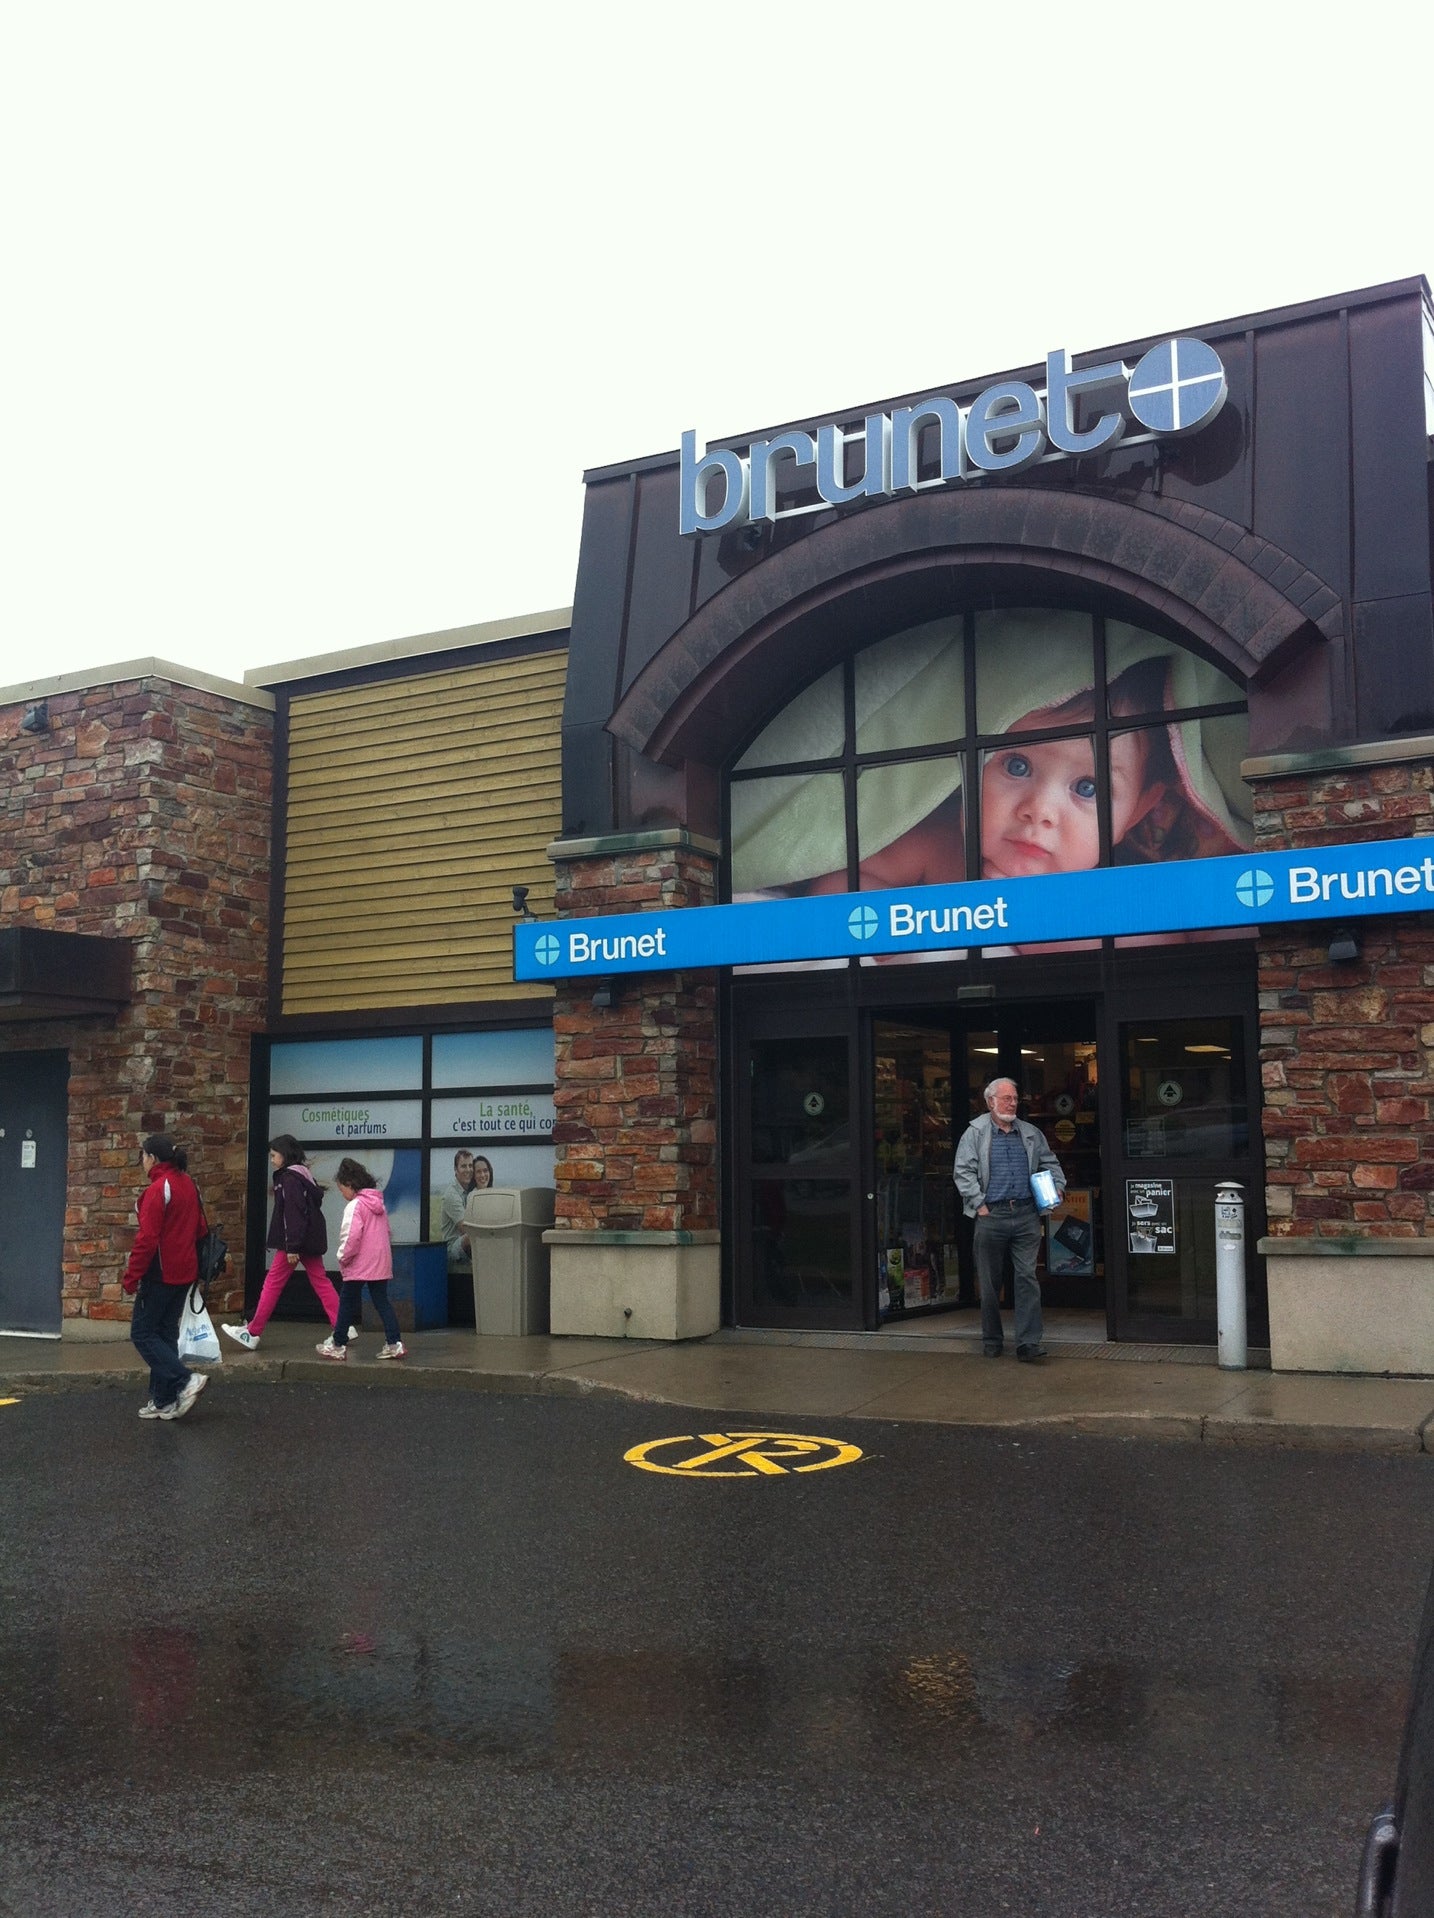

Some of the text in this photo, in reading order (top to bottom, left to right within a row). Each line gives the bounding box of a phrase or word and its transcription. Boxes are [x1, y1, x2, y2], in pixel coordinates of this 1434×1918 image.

[678, 348, 1127, 537] brunet
[1289, 857, 1434, 904] Brunet
[889, 896, 1009, 938] Brunet
[568, 926, 667, 964] Brunet
[301, 1107, 370, 1124] Cosmétiques
[480, 1099, 533, 1118] La santé,
[335, 1121, 387, 1137] et parfums
[452, 1118, 476, 1132] c'est
[480, 1118, 501, 1131] tout
[504, 1120, 516, 1130] ce
[519, 1116, 536, 1133] qui
[1146, 1188, 1172, 1198] panier
[1155, 1226, 1173, 1234] sac
